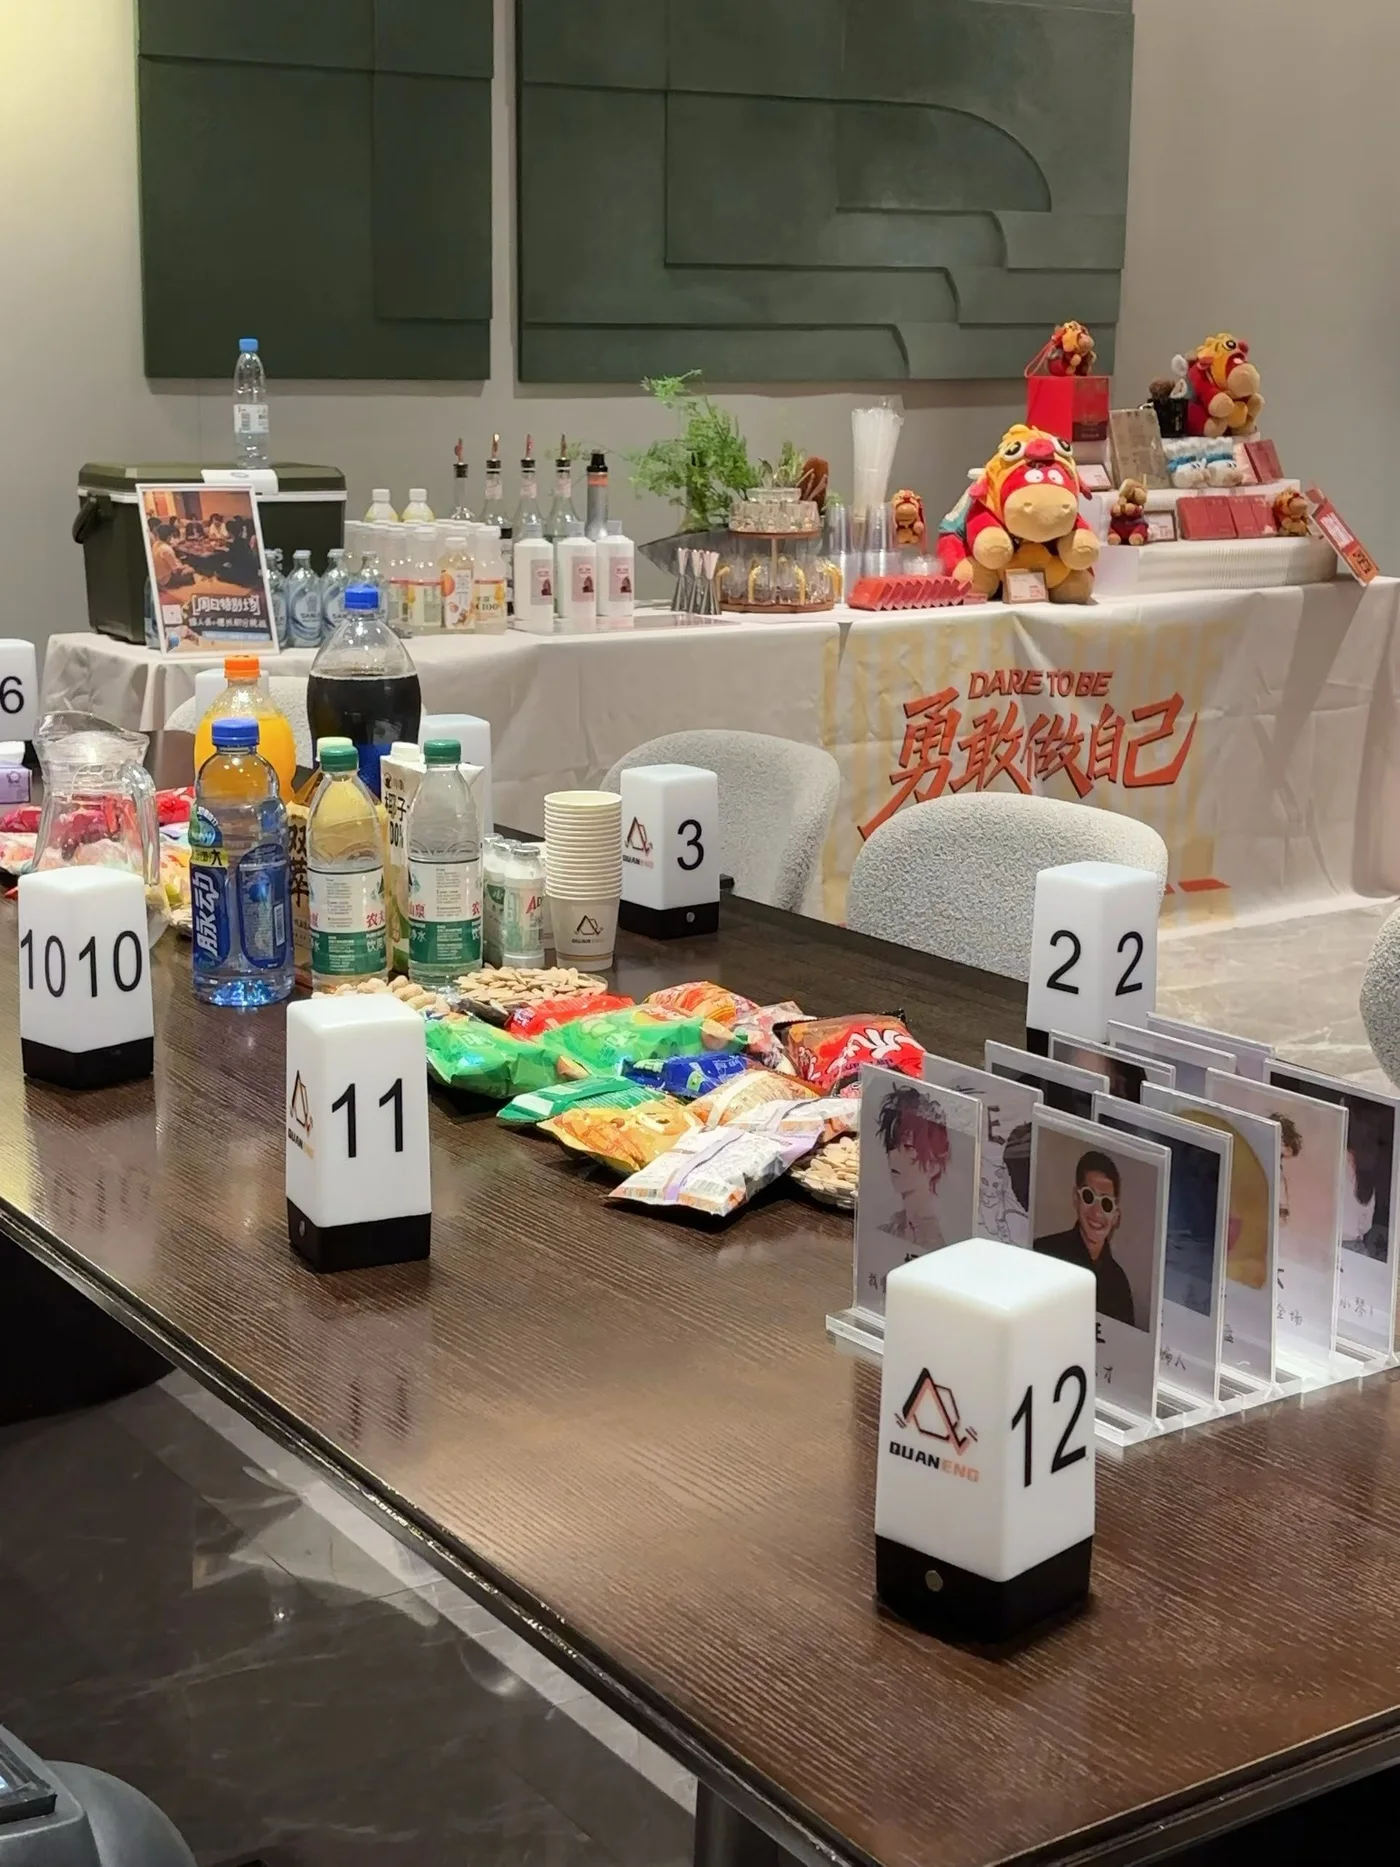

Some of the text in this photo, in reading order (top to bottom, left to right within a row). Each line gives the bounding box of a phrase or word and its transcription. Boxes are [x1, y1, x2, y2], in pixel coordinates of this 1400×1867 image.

[0, 676, 24, 715] 6
[968, 669, 1113, 699] DARE TO BE
[857, 687, 1198, 841] 勇敢做自己
[677, 819, 704, 870] 3
[192, 872, 220, 957] 脉动
[20, 929, 66, 998] 10
[79, 930, 142, 998] 10
[1046, 929, 1081, 995] 2
[1115, 931, 1143, 996] 2
[332, 1078, 403, 1158] 11
[1012, 1365, 1087, 1488] 12
